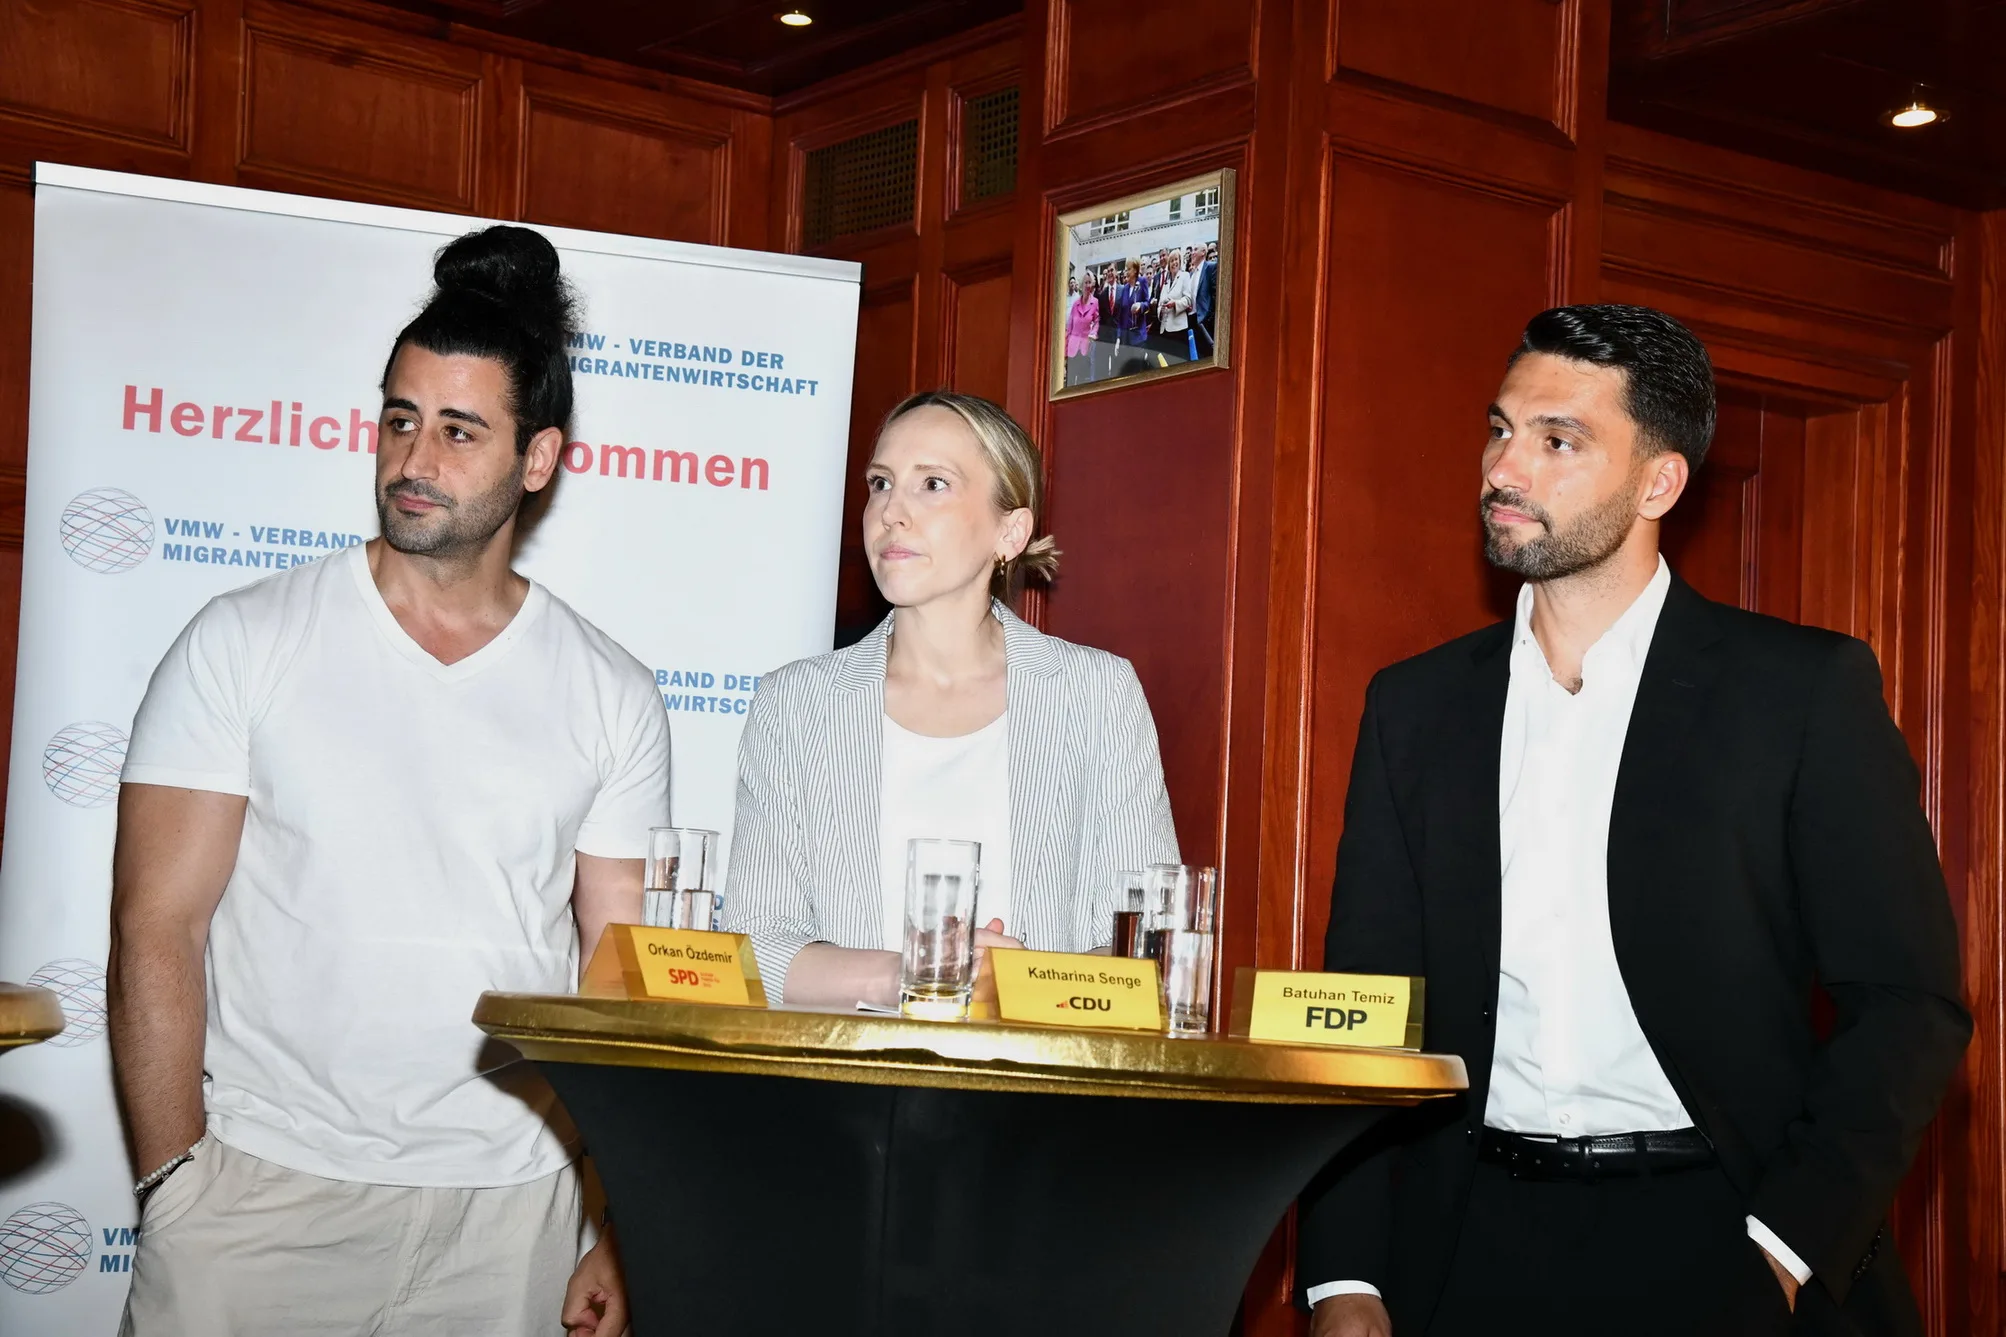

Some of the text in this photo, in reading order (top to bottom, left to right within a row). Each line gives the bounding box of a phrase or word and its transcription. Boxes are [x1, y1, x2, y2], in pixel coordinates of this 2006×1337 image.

[566, 331, 606, 351] MW
[628, 338, 733, 365] VERBAND
[740, 350, 784, 370] DER
[571, 355, 819, 396] IGRANTENWIRTSCHAFT
[121, 384, 770, 491] Herzlich ommen
[164, 518, 224, 539] VMW
[249, 526, 363, 549] VERBAND
[162, 543, 321, 570] MIGRANTEN
[655, 669, 715, 689] BAND
[664, 693, 747, 715] WIRTSC
[648, 943, 732, 963] Orkan Özdemir
[668, 968, 699, 986] SPD
[1028, 967, 1141, 989] Katharina Senge
[1069, 996, 1111, 1011] CDU
[1283, 987, 1395, 1005] Batuhan Temiz
[1306, 1006, 1367, 1031] FDP
[103, 1228, 138, 1246] VM
